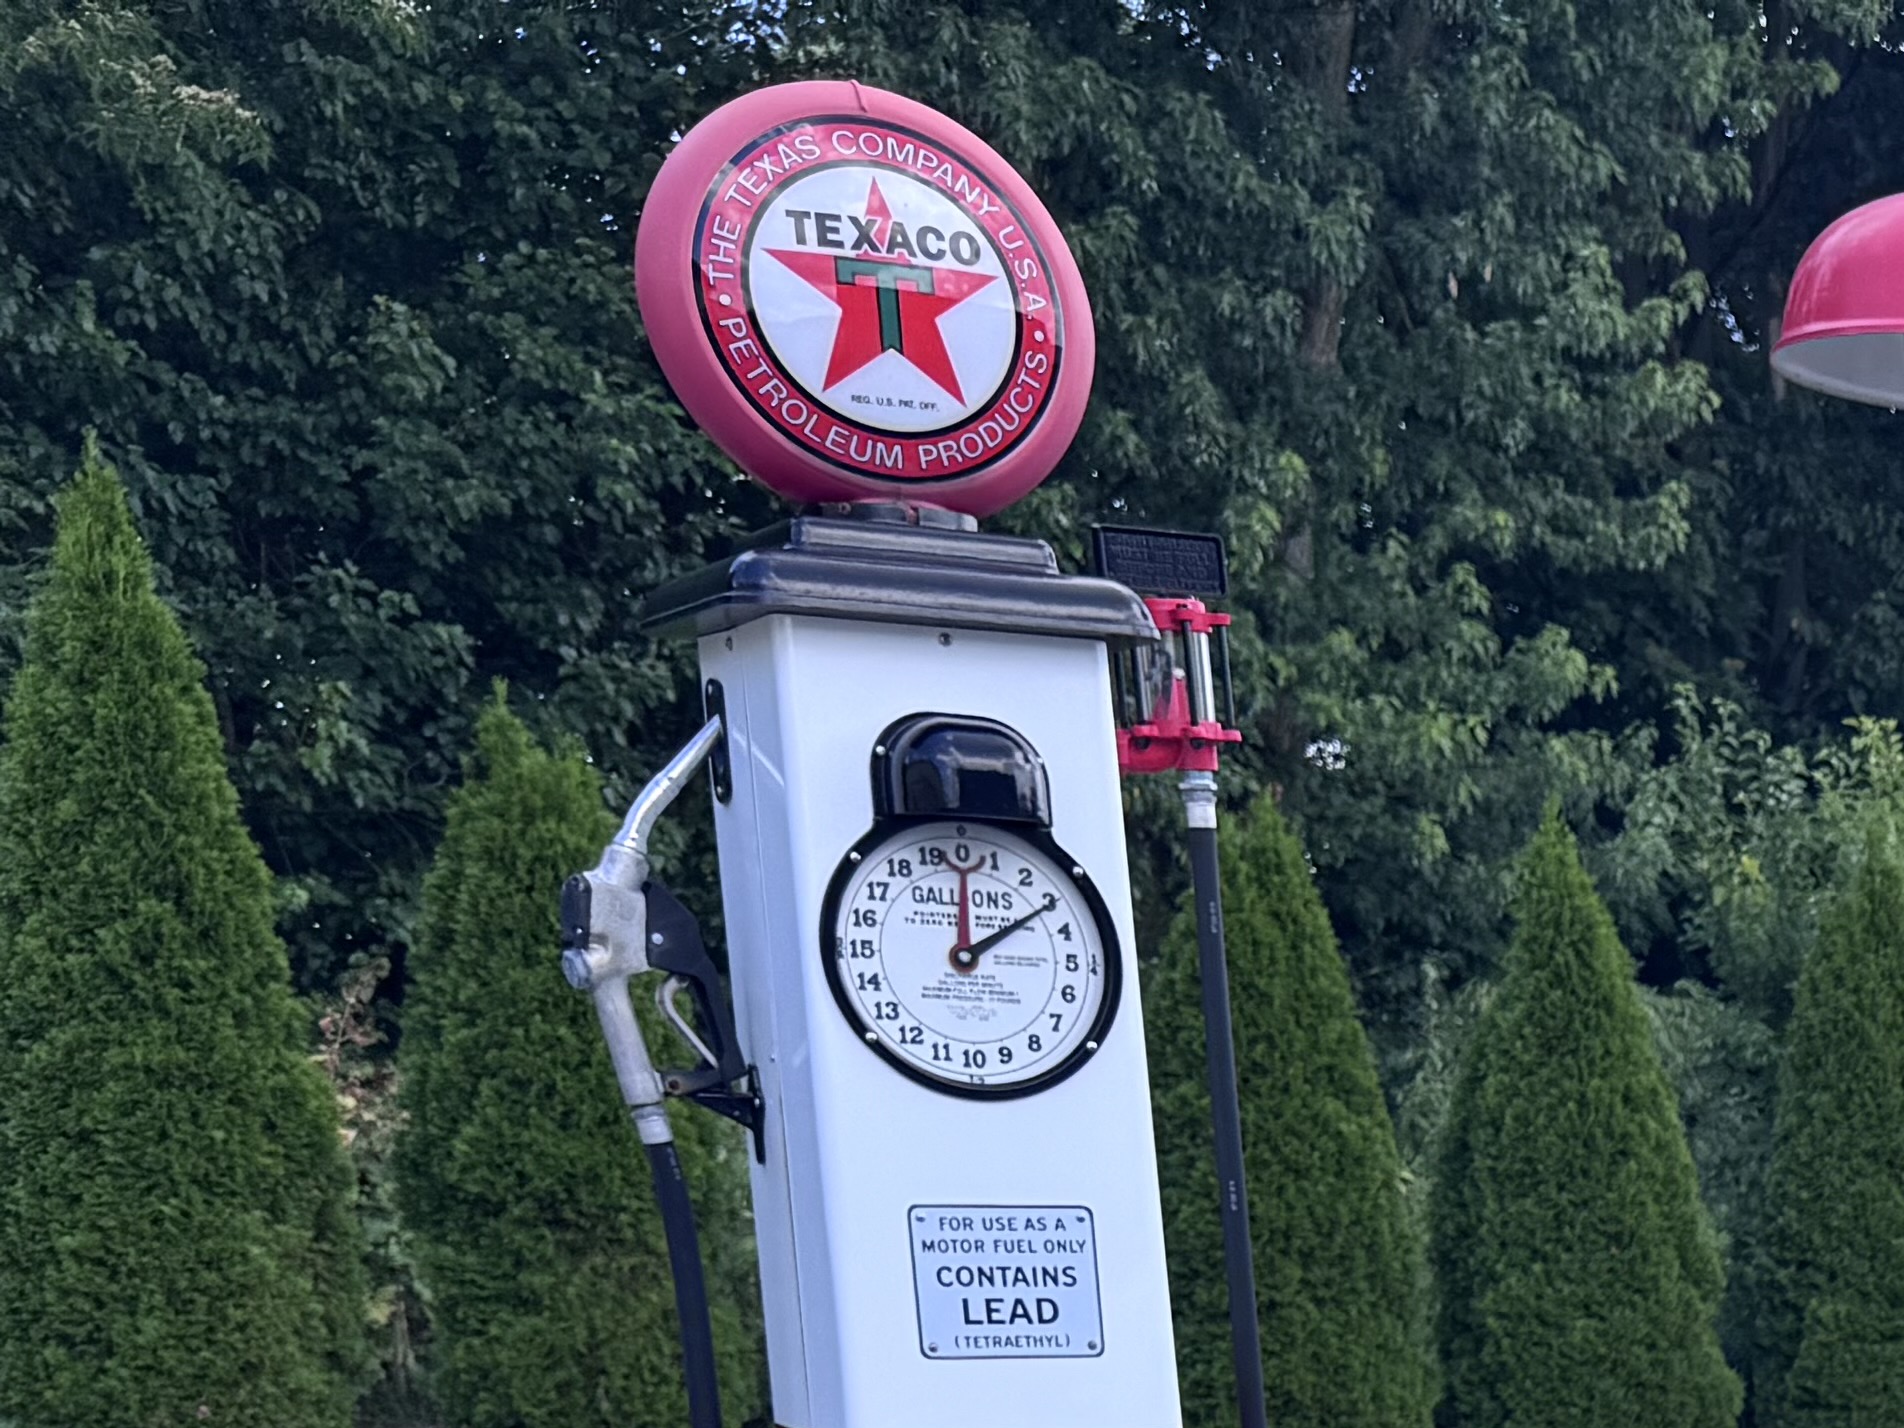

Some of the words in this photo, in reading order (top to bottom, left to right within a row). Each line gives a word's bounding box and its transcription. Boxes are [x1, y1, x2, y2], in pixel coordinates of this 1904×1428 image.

[724, 134, 820, 208] TEXAS
[832, 130, 999, 218] COMPANY
[785, 209, 981, 265] TEXACO
[709, 215, 742, 287] THE
[999, 224, 1050, 320] U.S.A.
[719, 316, 904, 469] PETROLEUM
[918, 353, 1048, 470] PRODUCTS
[918, 847, 943, 866] 19
[956, 844, 970, 862] 0
[990, 852, 1000, 871] 1
[887, 858, 912, 877] 18
[1018, 868, 1033, 887] 2
[867, 882, 890, 901] 17
[912, 885, 1013, 910] GALLONS
[1042, 893, 1057, 911] 3
[853, 909, 877, 927] 16
[1057, 923, 1072, 941] 4
[850, 940, 875, 958] 15
[1066, 954, 1079, 972] 5
[858, 973, 882, 991] 14
[1062, 985, 1076, 1003] 6
[875, 1002, 900, 1020] 13
[1049, 1014, 1062, 1032] 7
[899, 1027, 924, 1045] 12
[1028, 1034, 1041, 1051] 8
[932, 1043, 952, 1061] 11
[963, 1050, 986, 1068] 10
[999, 1047, 1013, 1064] 9
[939, 1217, 974, 1231] FOR
[982, 1217, 1018, 1231] USE
[1024, 1217, 1047, 1231] AS
[1055, 1217, 1067, 1231] A
[921, 1239, 985, 1253] MOTOR
[993, 1239, 1037, 1253] FUEL
[1043, 1239, 1086, 1253] ONLY
[937, 1265, 1078, 1287] CONTAINS
[961, 1297, 1060, 1325] LEAD
